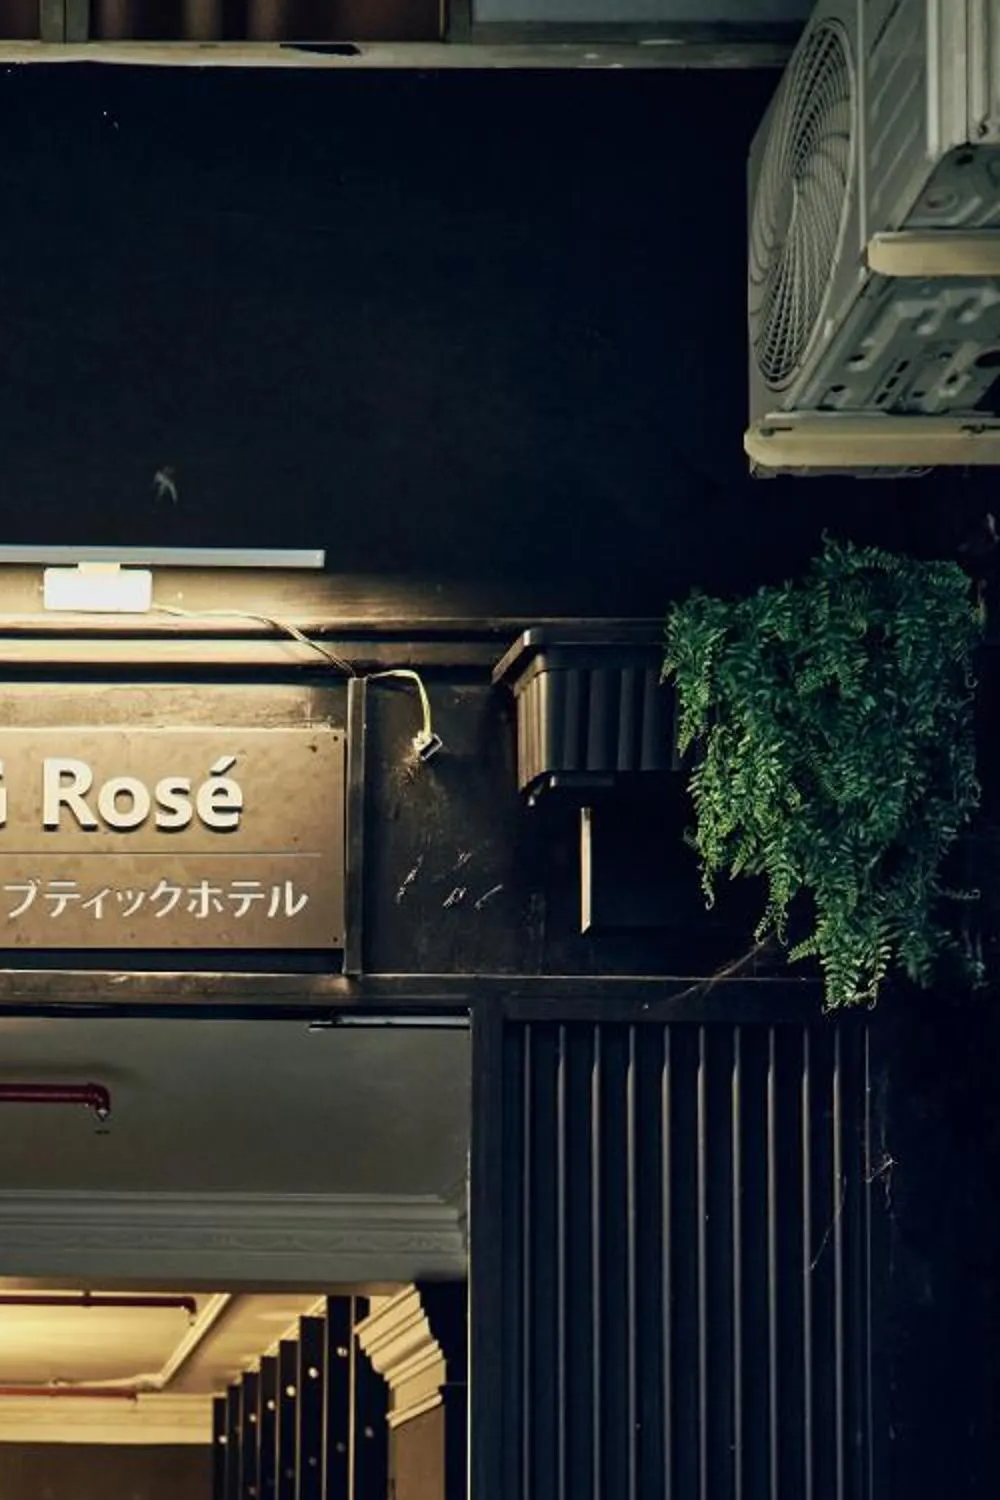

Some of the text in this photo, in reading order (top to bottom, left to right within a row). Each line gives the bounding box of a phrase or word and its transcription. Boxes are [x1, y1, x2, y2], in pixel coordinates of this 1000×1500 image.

[41, 755, 243, 830] Rosé
[2, 878, 308, 919] ブティックホテル
